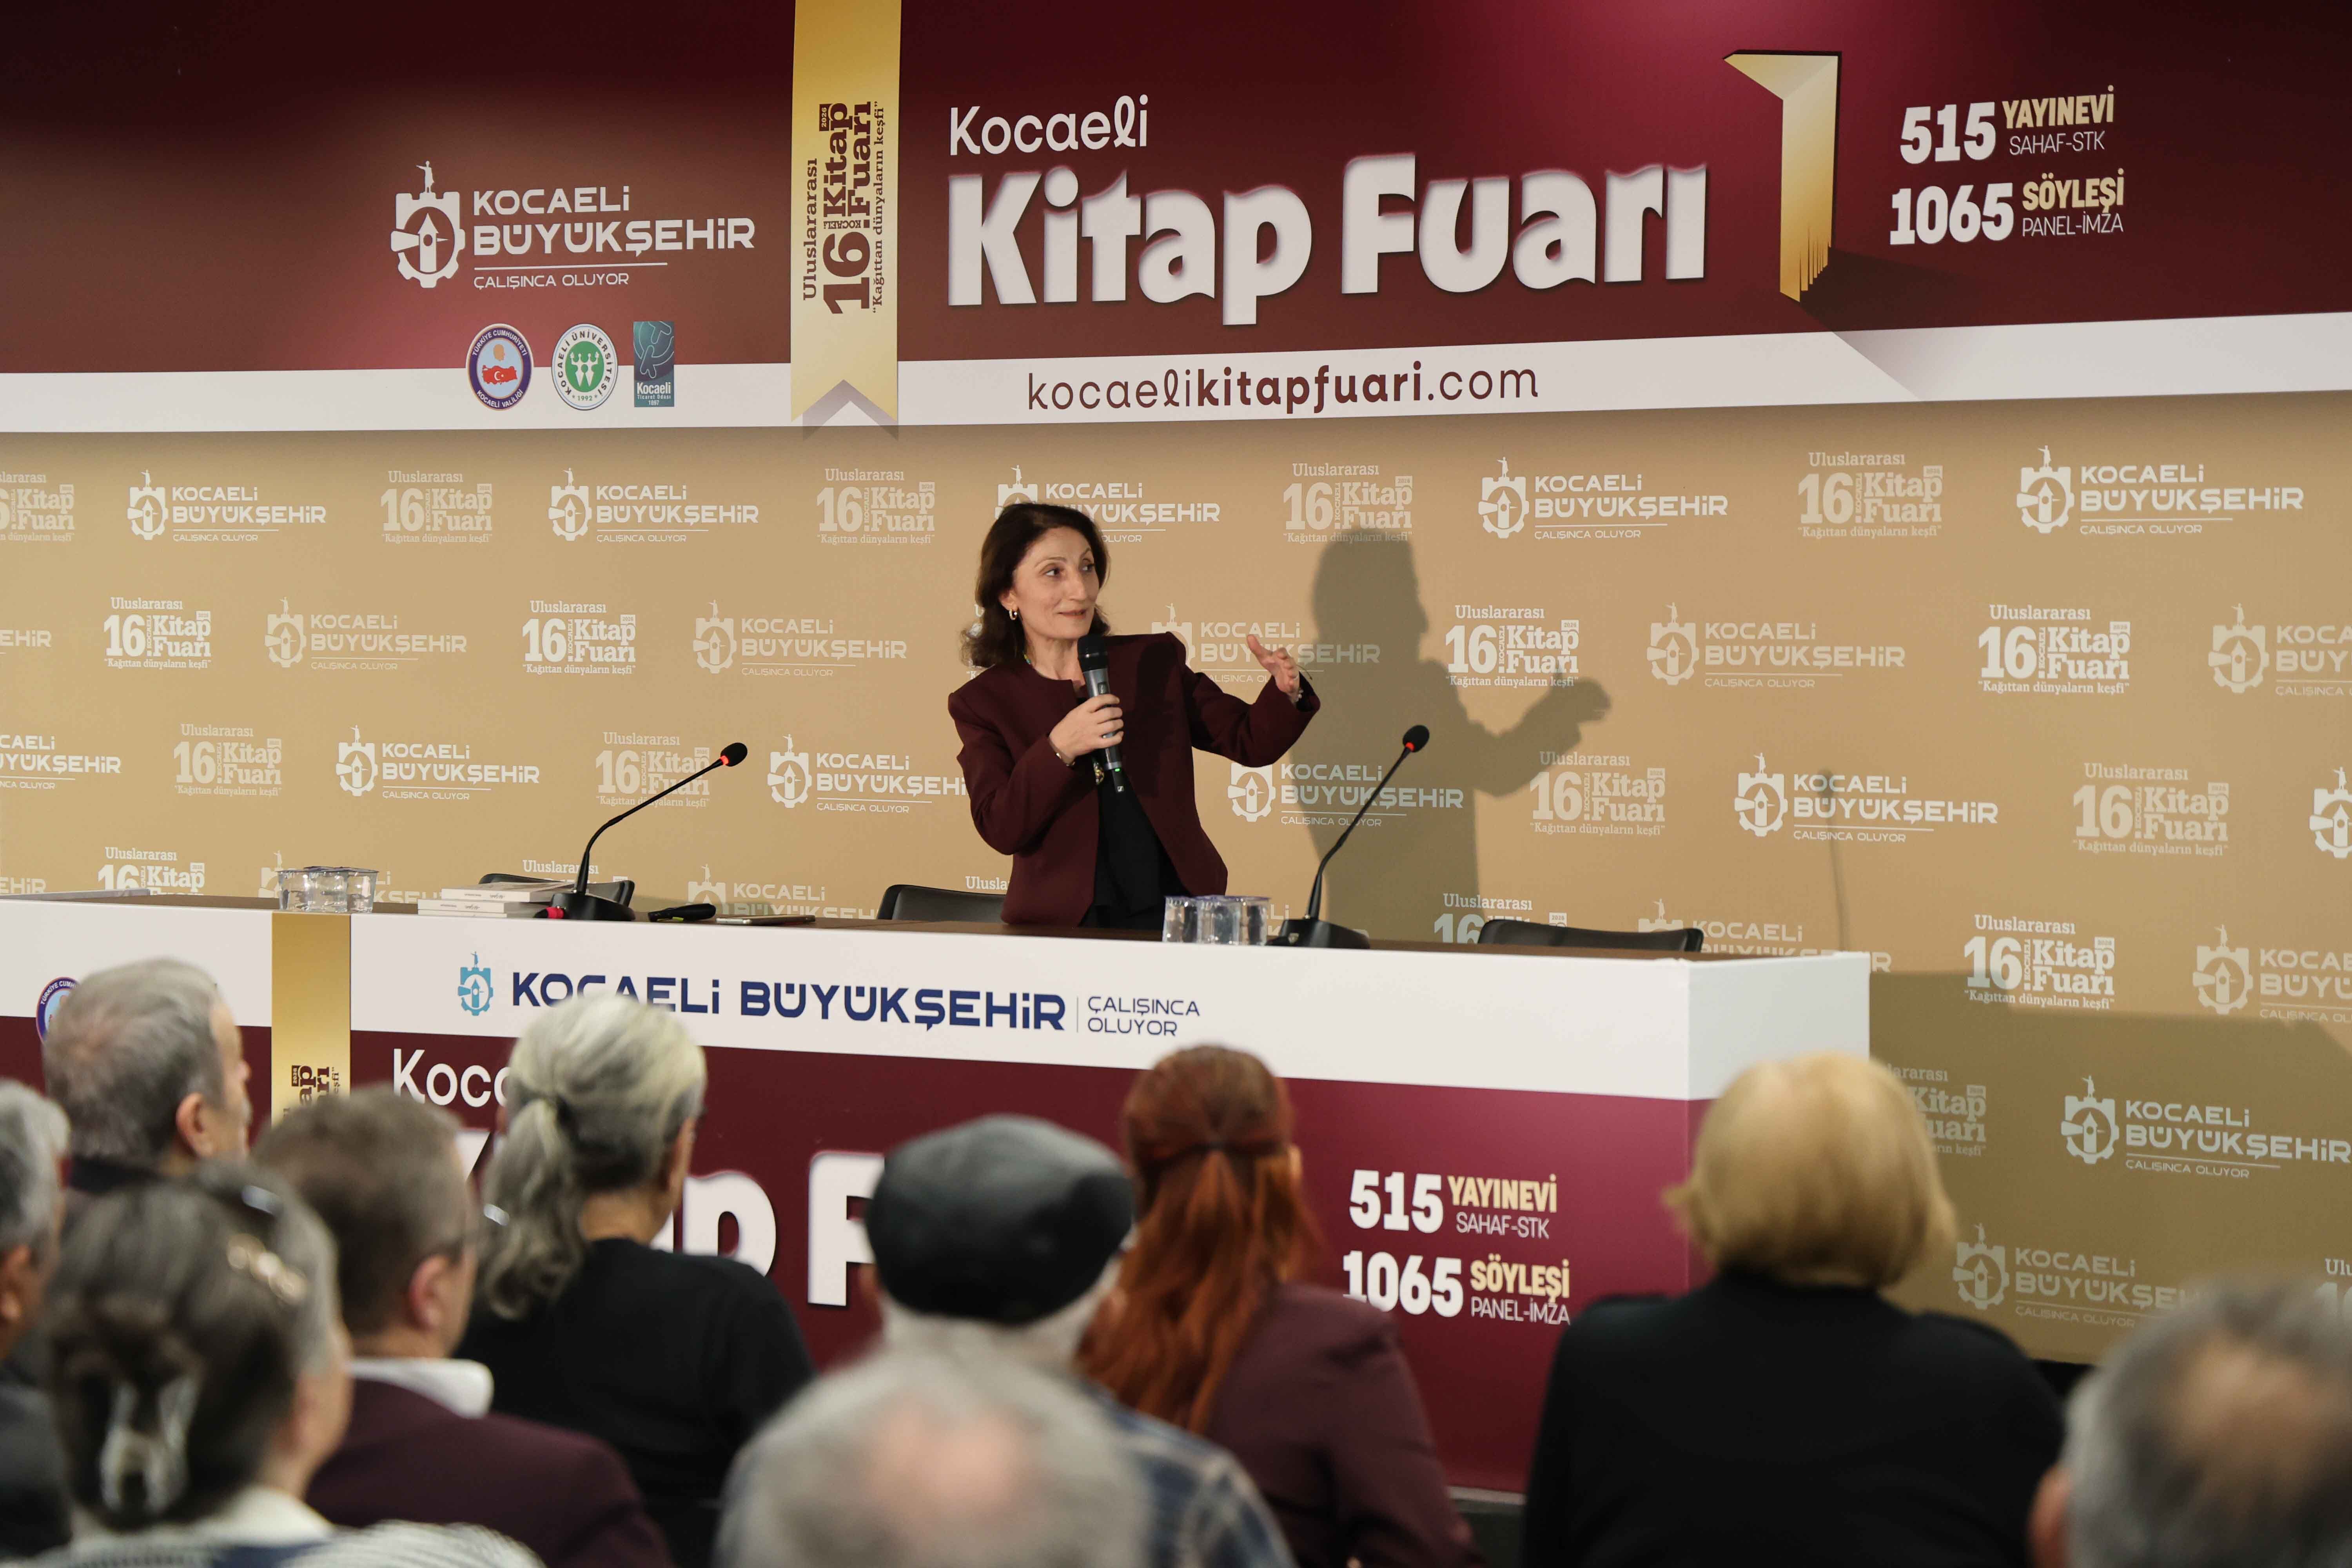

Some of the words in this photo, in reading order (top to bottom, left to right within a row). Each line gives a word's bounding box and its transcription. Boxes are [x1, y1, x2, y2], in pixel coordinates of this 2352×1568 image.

[951, 94, 1148, 155] Kocaeli
[1900, 102, 1995, 164] 515
[2002, 85, 2114, 129] YAYINEVİ
[2010, 131, 2105, 155] SAHAF-STK
[824, 103, 853, 217] Kitap
[848, 102, 871, 216] Fuarı
[1890, 183, 2013, 245] 1065
[2022, 168, 2124, 214] SÖYLEŞİ
[803, 158, 817, 300] Uluslararası
[2023, 211, 2123, 236] PANEL-İMZA
[948, 165, 1312, 326] Kitap
[1341, 152, 1708, 296] Fuarı
[563, 273, 629, 286] OLUYOR
[472, 332, 492, 356] TÜRKİYE
[557, 339, 572, 395] KOCAELİ
[477, 390, 500, 408] KOCAELİ
[637, 382, 671, 394] Kocaeli
[1029, 361, 1538, 414] kocaelikitapfuari.com
[388, 470, 463, 483] Uluslararası
[825, 468, 904, 481] Uluslararası
[1292, 463, 1379, 476] Uluslararası
[432, 489, 492, 514] Kitap
[871, 487, 935, 514] Kitap
[1342, 479, 1412, 510] Kitap
[432, 510, 492, 531] Fuarı
[871, 510, 935, 531] Fuarı
[1342, 503, 1412, 529] Fuarı
[1595, 530, 1641, 538] OLUYOR
[2150, 524, 2202, 534] OLUYOR
[111, 597, 183, 610] Uluslararası
[530, 600, 606, 613] Uluslararası
[1455, 605, 1544, 619] Uluslararası
[1989, 604, 2091, 620] Uluslararası
[153, 614, 211, 644] Kitap
[574, 616, 635, 646] Kitap
[1506, 625, 1579, 655] Kitap
[153, 635, 211, 657] Fuarı
[574, 641, 635, 662] Fuarı
[2048, 624, 2130, 663] Kitap
[1506, 650, 1578, 673] Fuarı
[2047, 650, 2129, 679] Fuarı
[181, 723, 253, 737] Uluslararası
[223, 742, 281, 769] Kitap
[1540, 751, 1630, 766] Uluslararası
[223, 764, 281, 784] Fuarı
[2084, 763, 2188, 780] Uluslararası
[1592, 769, 1665, 803] Kitap
[1592, 797, 1665, 822] Fuarı
[2144, 784, 2229, 821] Kitap
[1857, 833, 1906, 842] OLUYOR
[2143, 811, 2228, 841] Fuarı
[105, 847, 177, 861] Uluslararası
[147, 863, 204, 893] Kitap
[1444, 894, 1532, 910] Uluslararası
[1975, 915, 2075, 935] Uluslararası
[2033, 938, 2114, 977] Kitap
[2033, 964, 2114, 995] Fuarı
[1088, 1018, 1177, 1036] OLUYOR
[2196, 1165, 2249, 1178] OLUYOR
[1350, 1170, 1443, 1233] 515
[1448, 1174, 1556, 1212] YAYINEVİ
[1457, 1212, 1549, 1239] SAHAF-STK
[1343, 1251, 1463, 1317] 1065
[1470, 1254, 1569, 1307] SÖYLEŞİ
[1471, 1293, 1570, 1325] PANEL-İMZA
